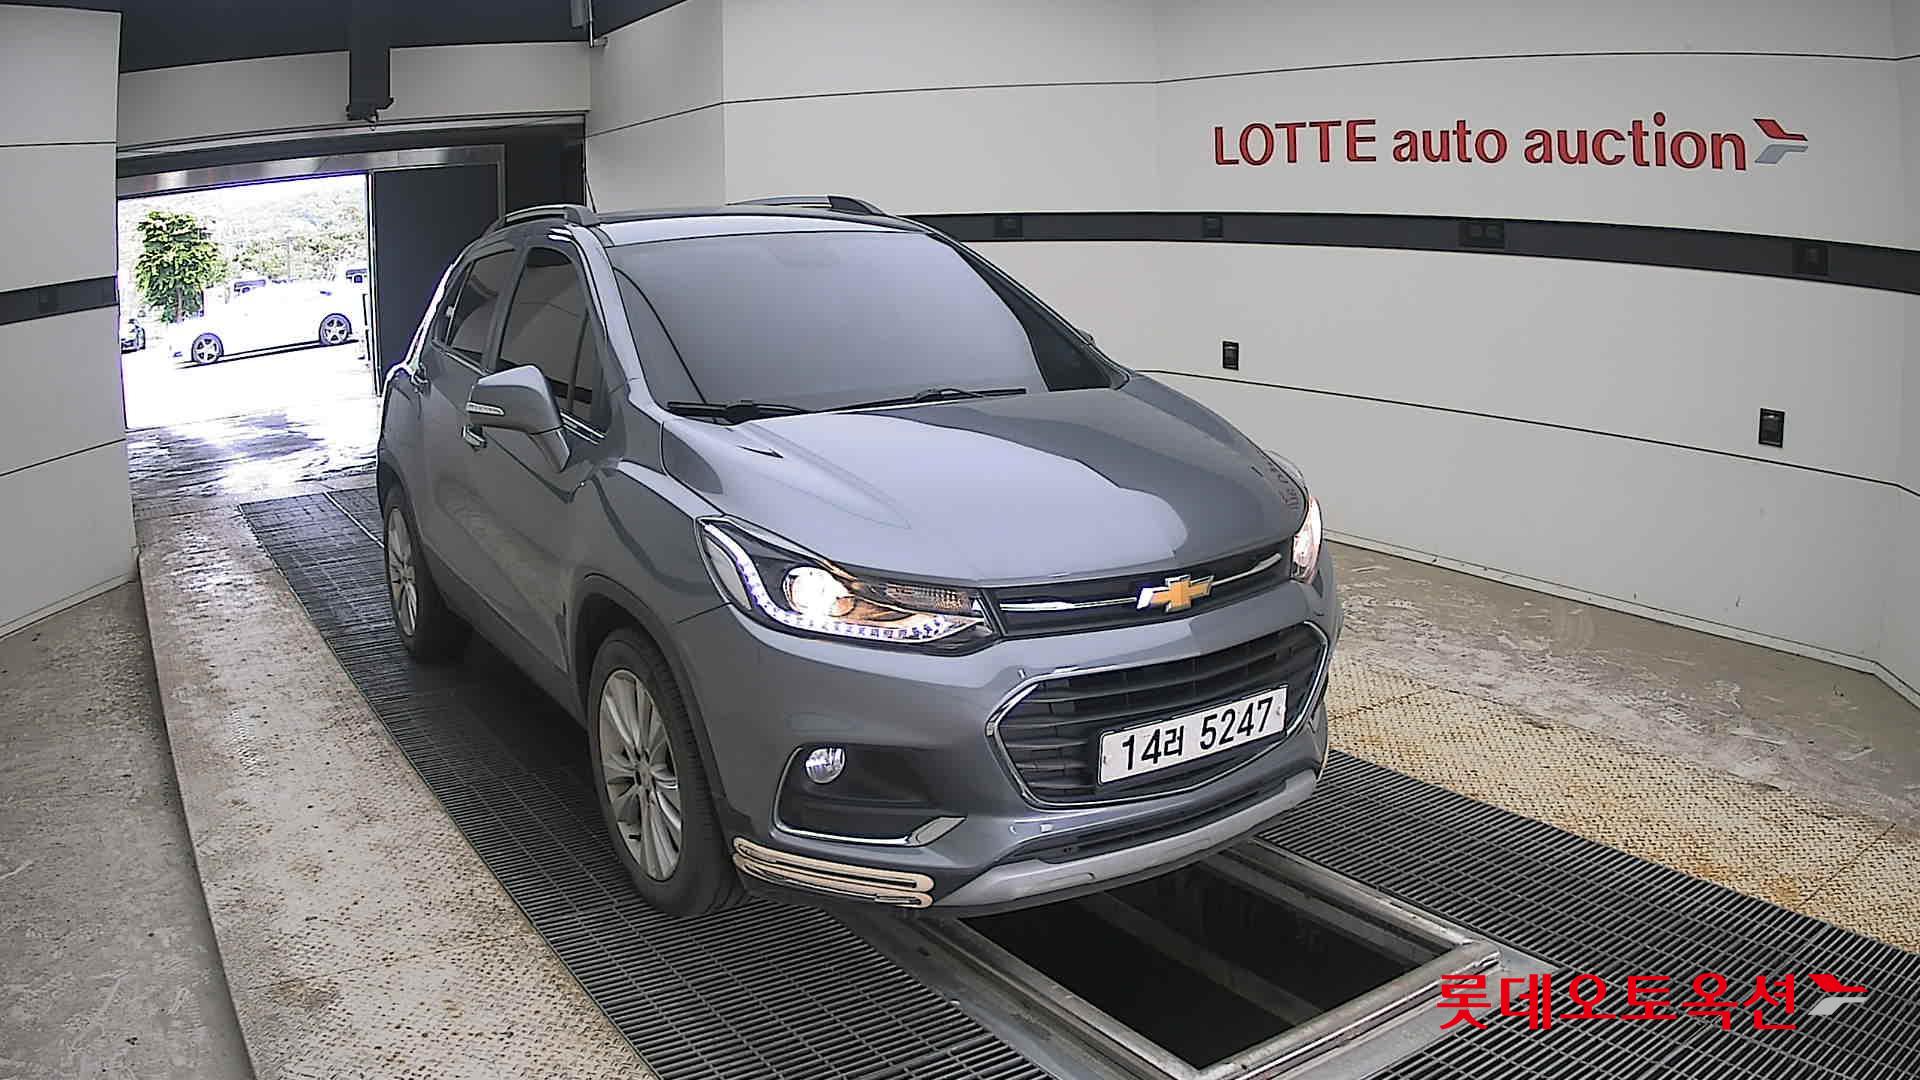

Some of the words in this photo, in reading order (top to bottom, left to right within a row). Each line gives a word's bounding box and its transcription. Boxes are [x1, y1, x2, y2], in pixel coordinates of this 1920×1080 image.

[1213, 119, 1377, 166] LOTTE
[1392, 119, 1509, 164] auto
[1523, 111, 1747, 171] auction
[1121, 724, 1185, 770] 14러
[1199, 696, 1275, 750] 5247
